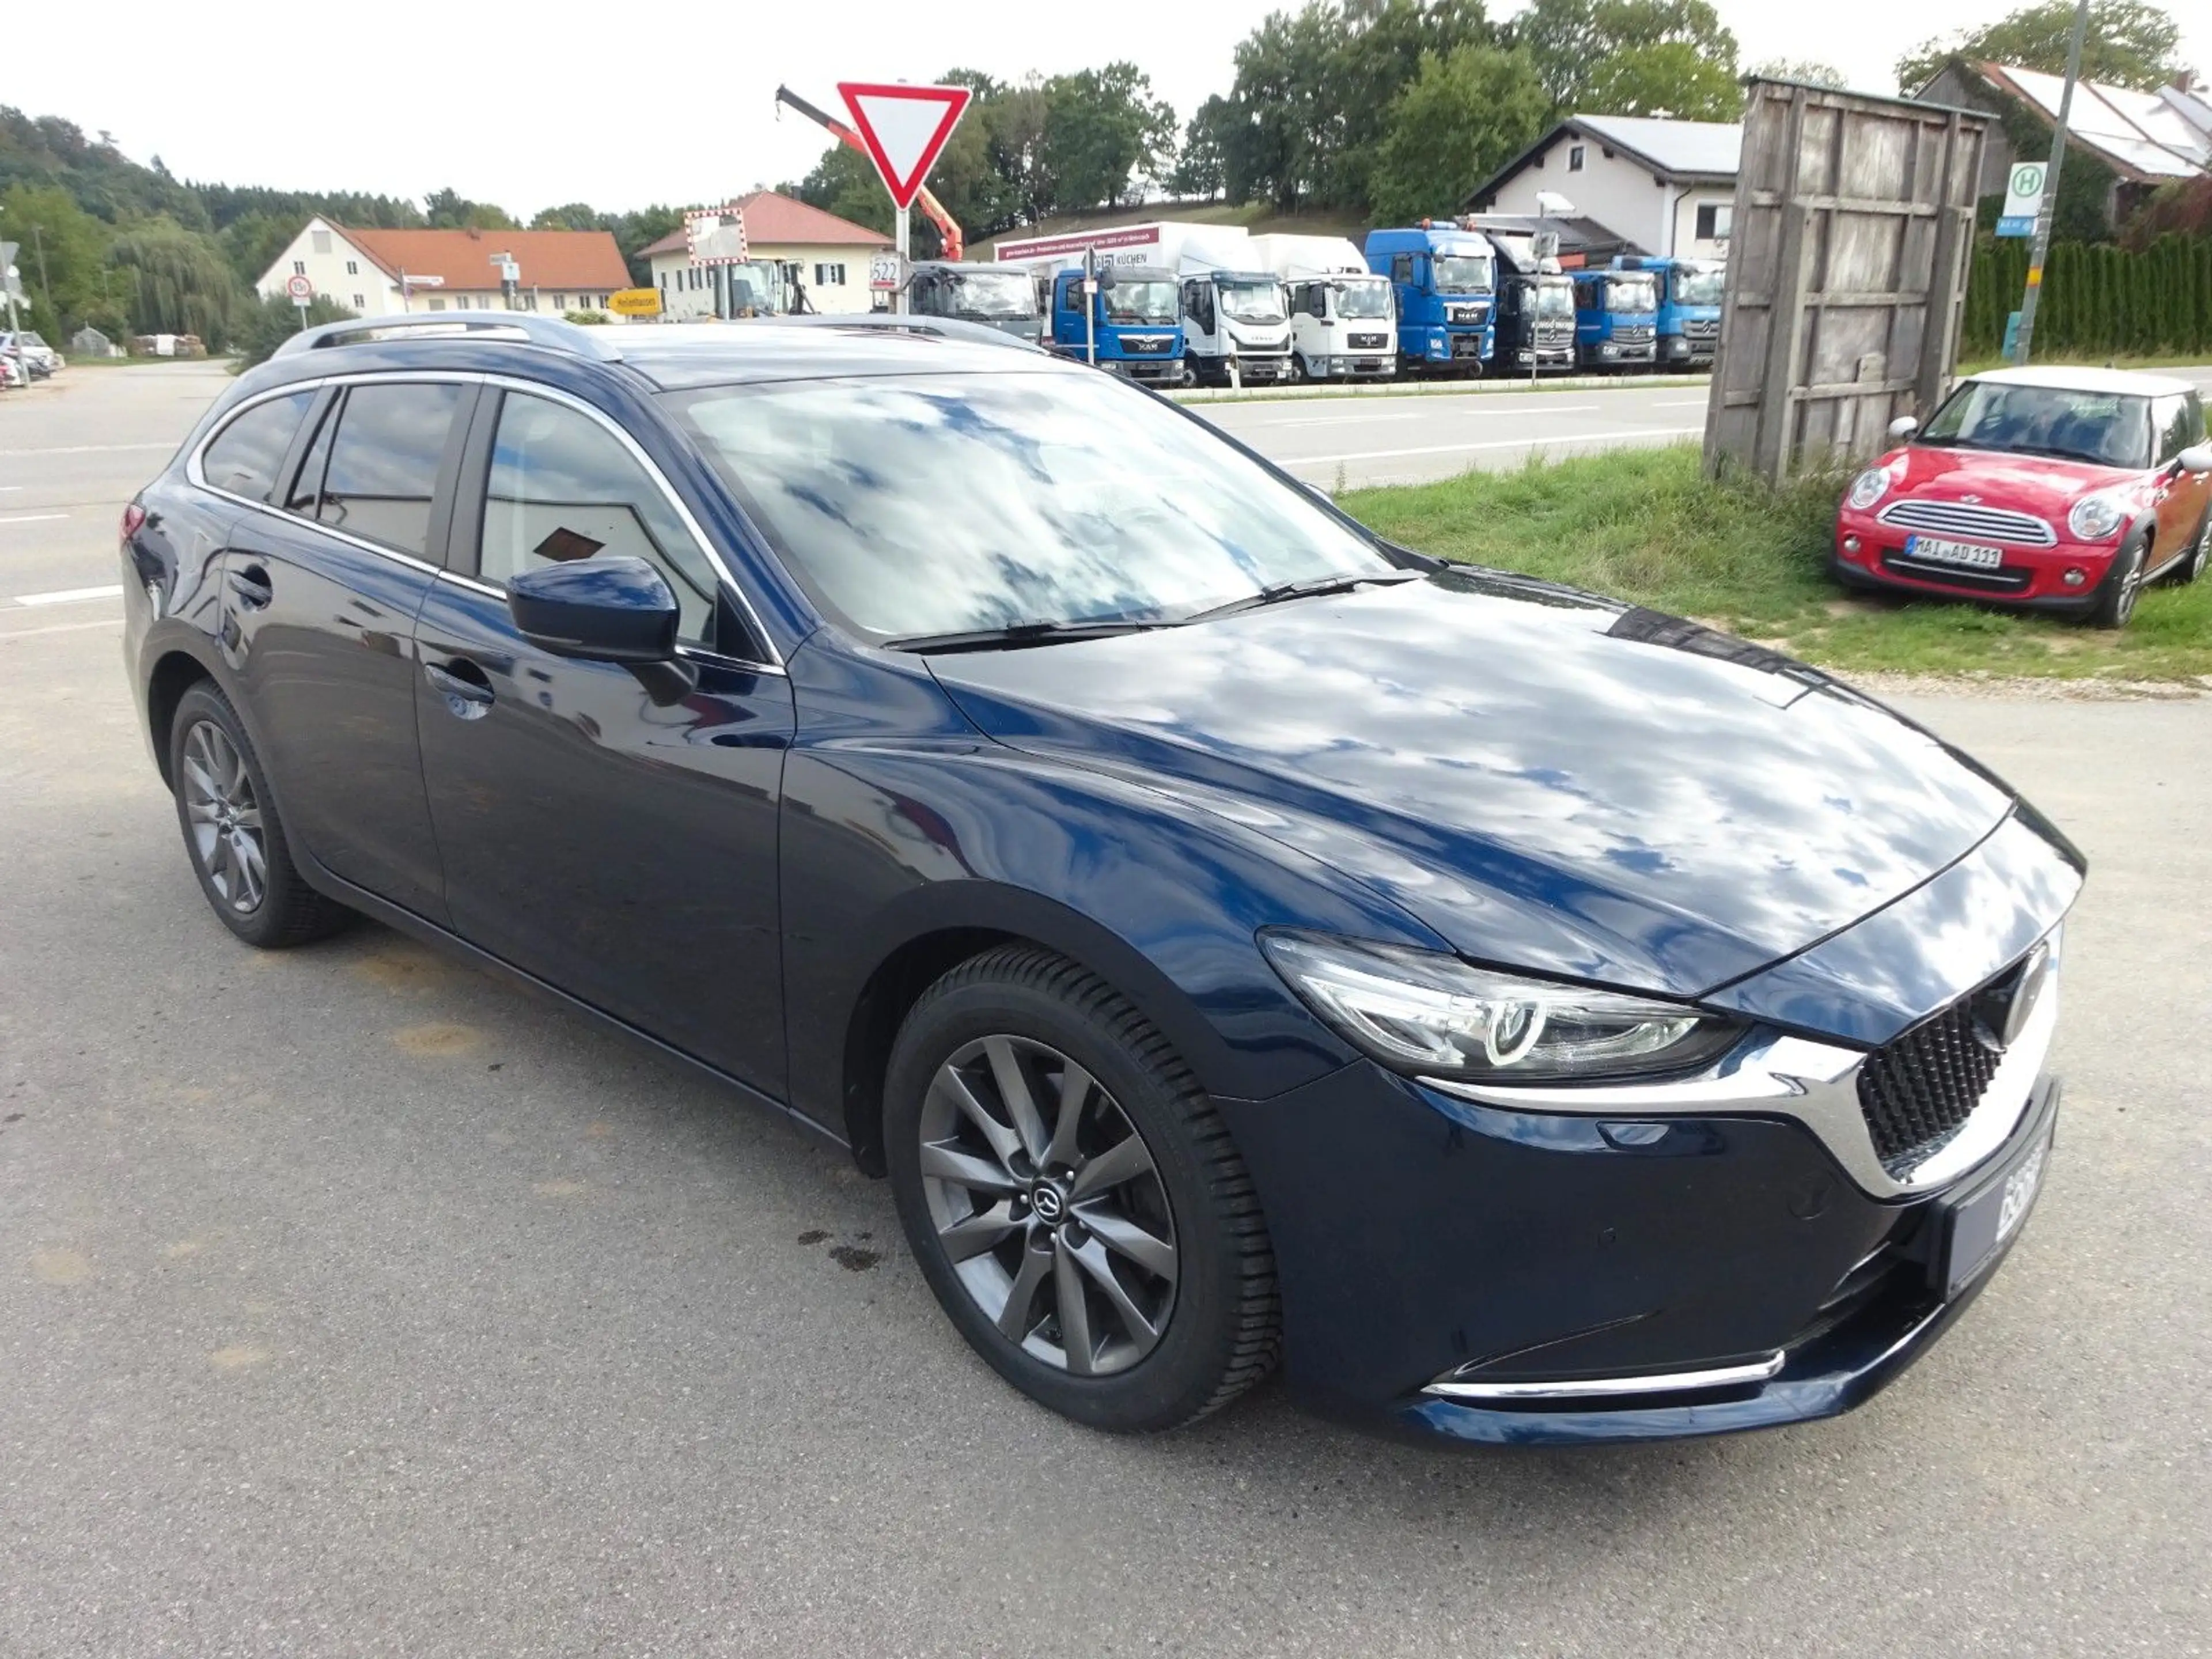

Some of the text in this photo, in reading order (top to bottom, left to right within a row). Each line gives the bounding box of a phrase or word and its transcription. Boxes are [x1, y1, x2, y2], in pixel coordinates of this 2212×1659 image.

[2018, 172, 2036, 191] H
[1116, 252, 1147, 265] KÜCHEN
[873, 262, 897, 281] 522
[1916, 540, 1998, 565] MAI AD 111
